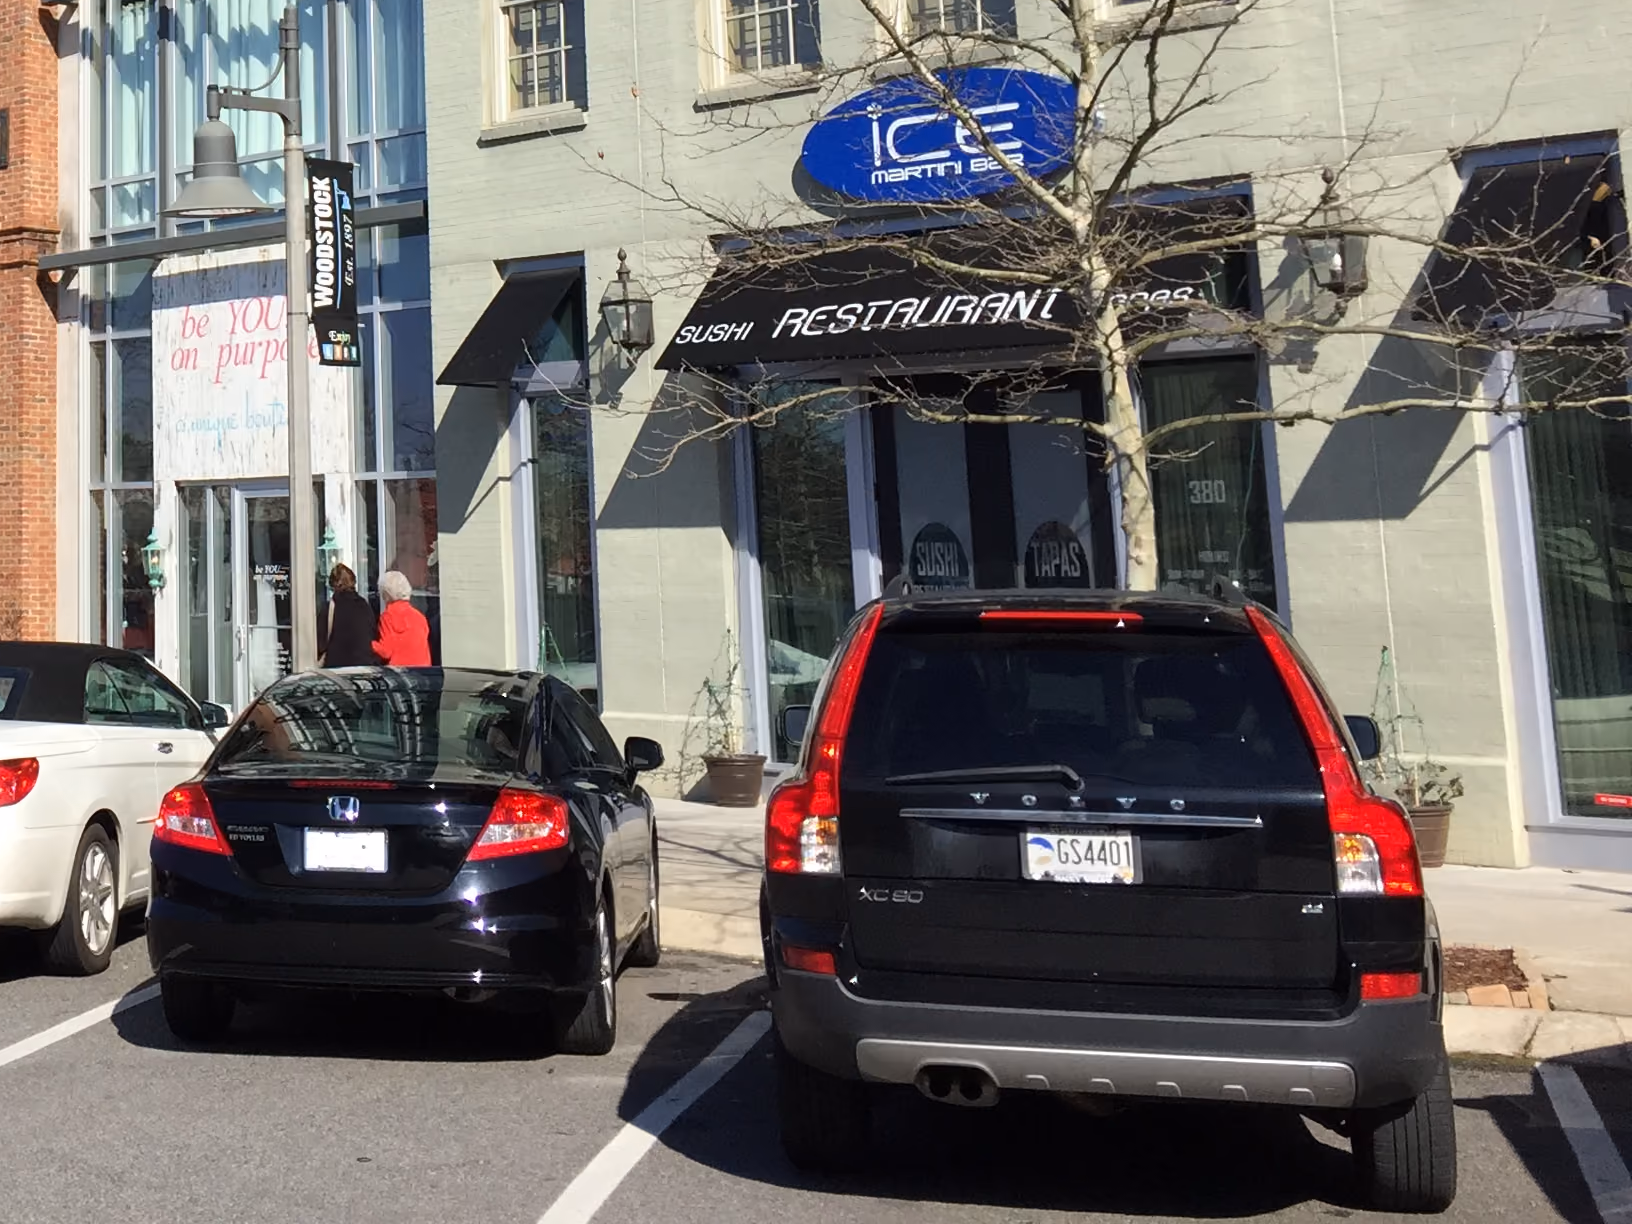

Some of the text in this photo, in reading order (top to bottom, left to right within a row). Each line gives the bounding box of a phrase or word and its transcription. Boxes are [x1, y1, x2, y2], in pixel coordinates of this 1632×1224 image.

[312, 176, 335, 308] WOODSTOCK
[343, 214, 354, 287] Est. 1897
[180, 304, 210, 340] be
[675, 321, 756, 345] SUSHI
[771, 287, 1064, 340] RESTAURANT
[171, 347, 198, 371] on
[1188, 479, 1226, 504] 380
[915, 542, 960, 577] SUSHI
[1030, 540, 1081, 577] TAPAS
[969, 792, 1186, 811] VOLVO
[1056, 838, 1132, 868] GS4401
